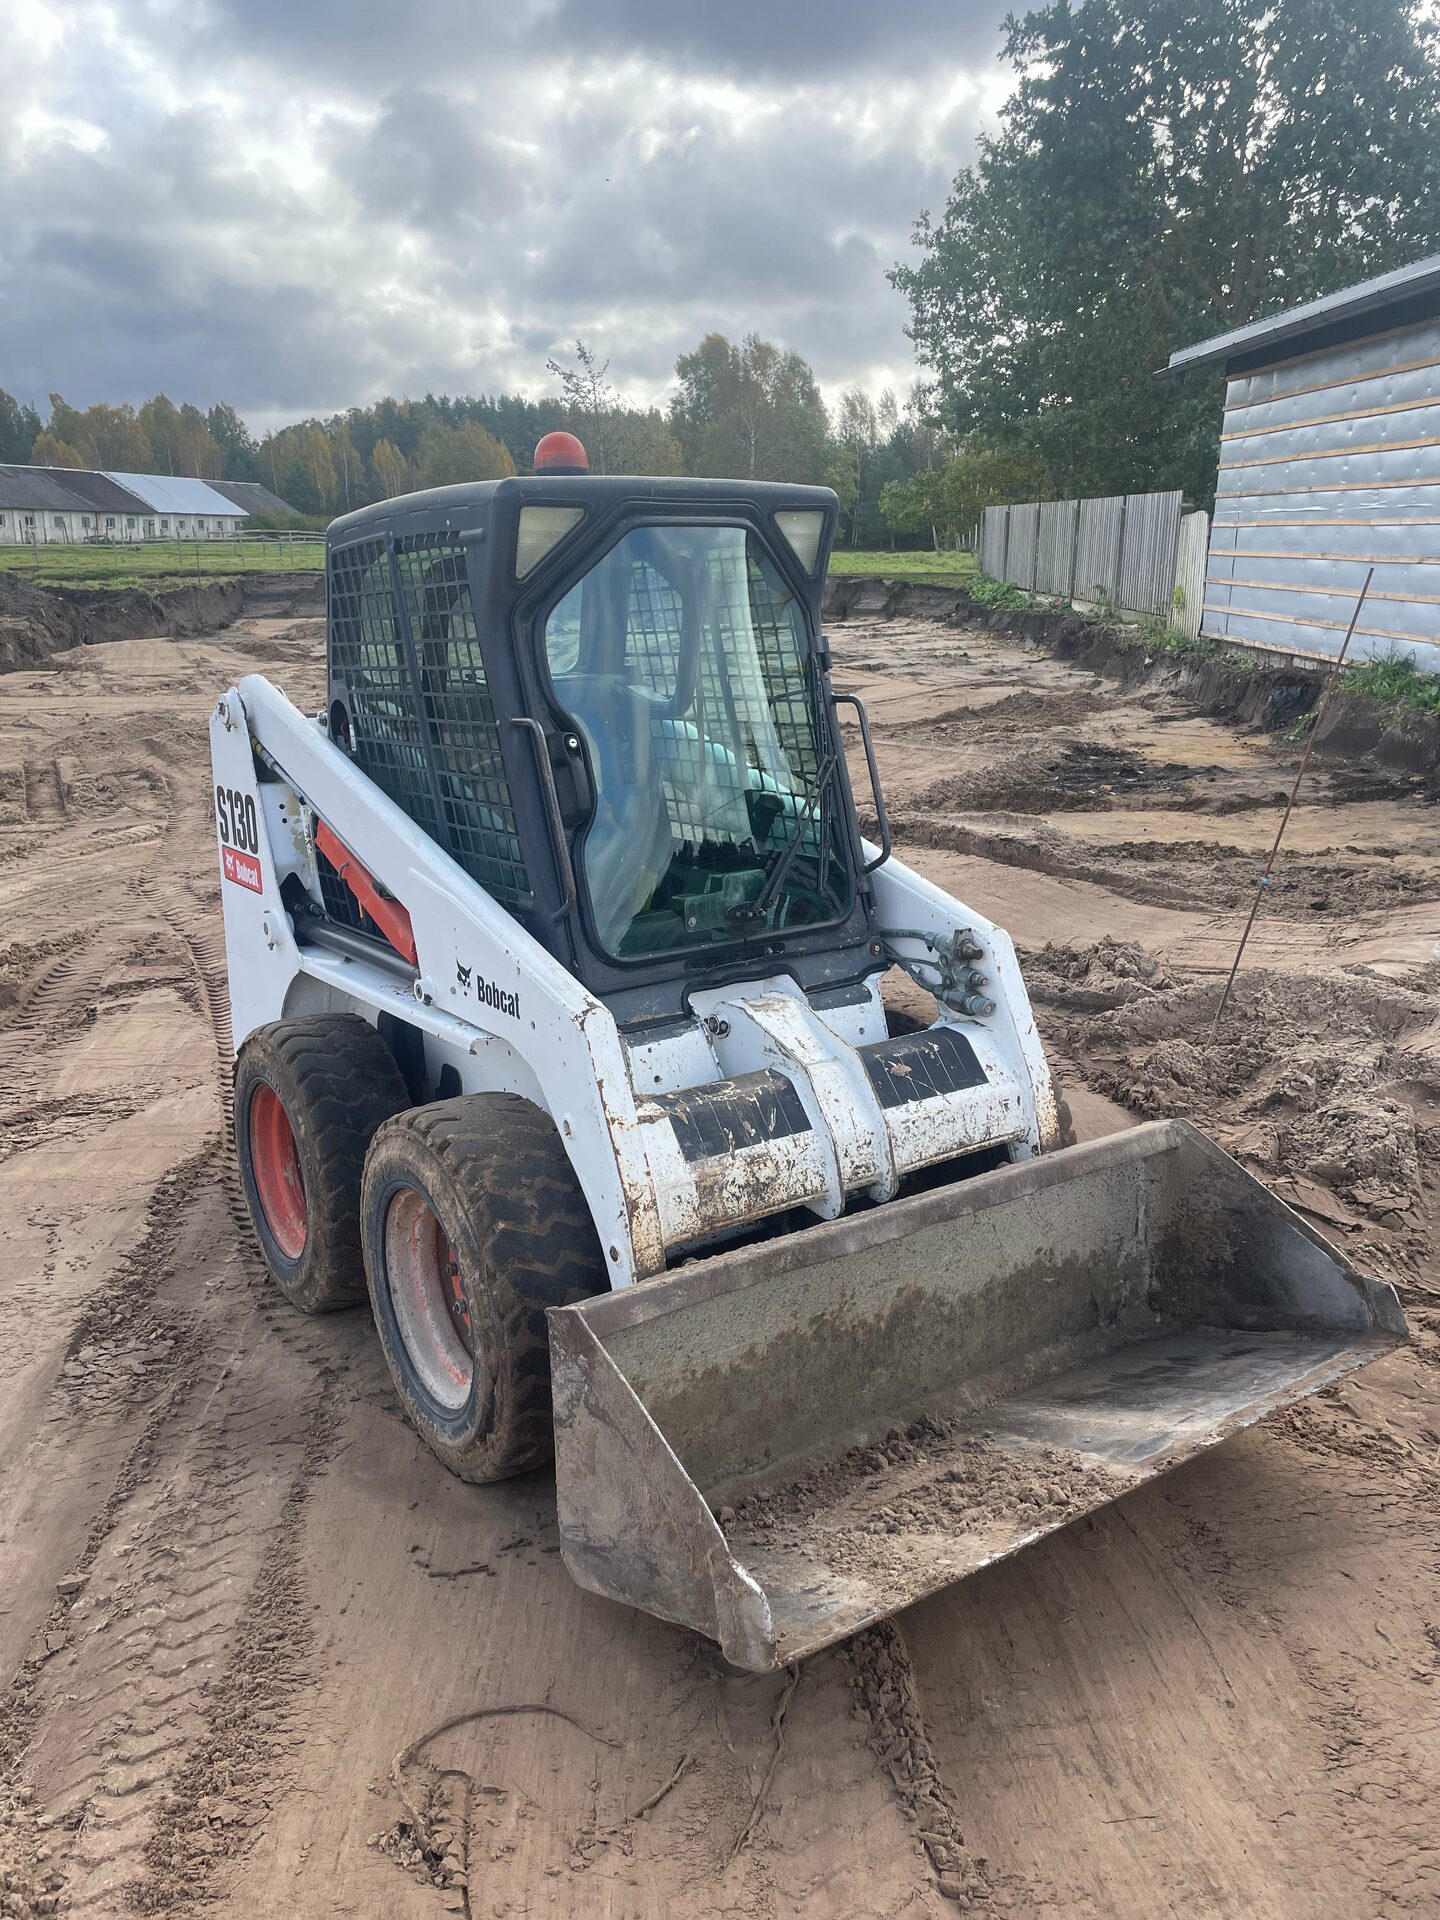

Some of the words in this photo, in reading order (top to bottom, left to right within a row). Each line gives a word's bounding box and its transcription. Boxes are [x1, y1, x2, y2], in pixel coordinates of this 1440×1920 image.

[216, 785, 259, 855] S130
[235, 859, 259, 887] Bobcat
[476, 974, 521, 1020] Bobcat
